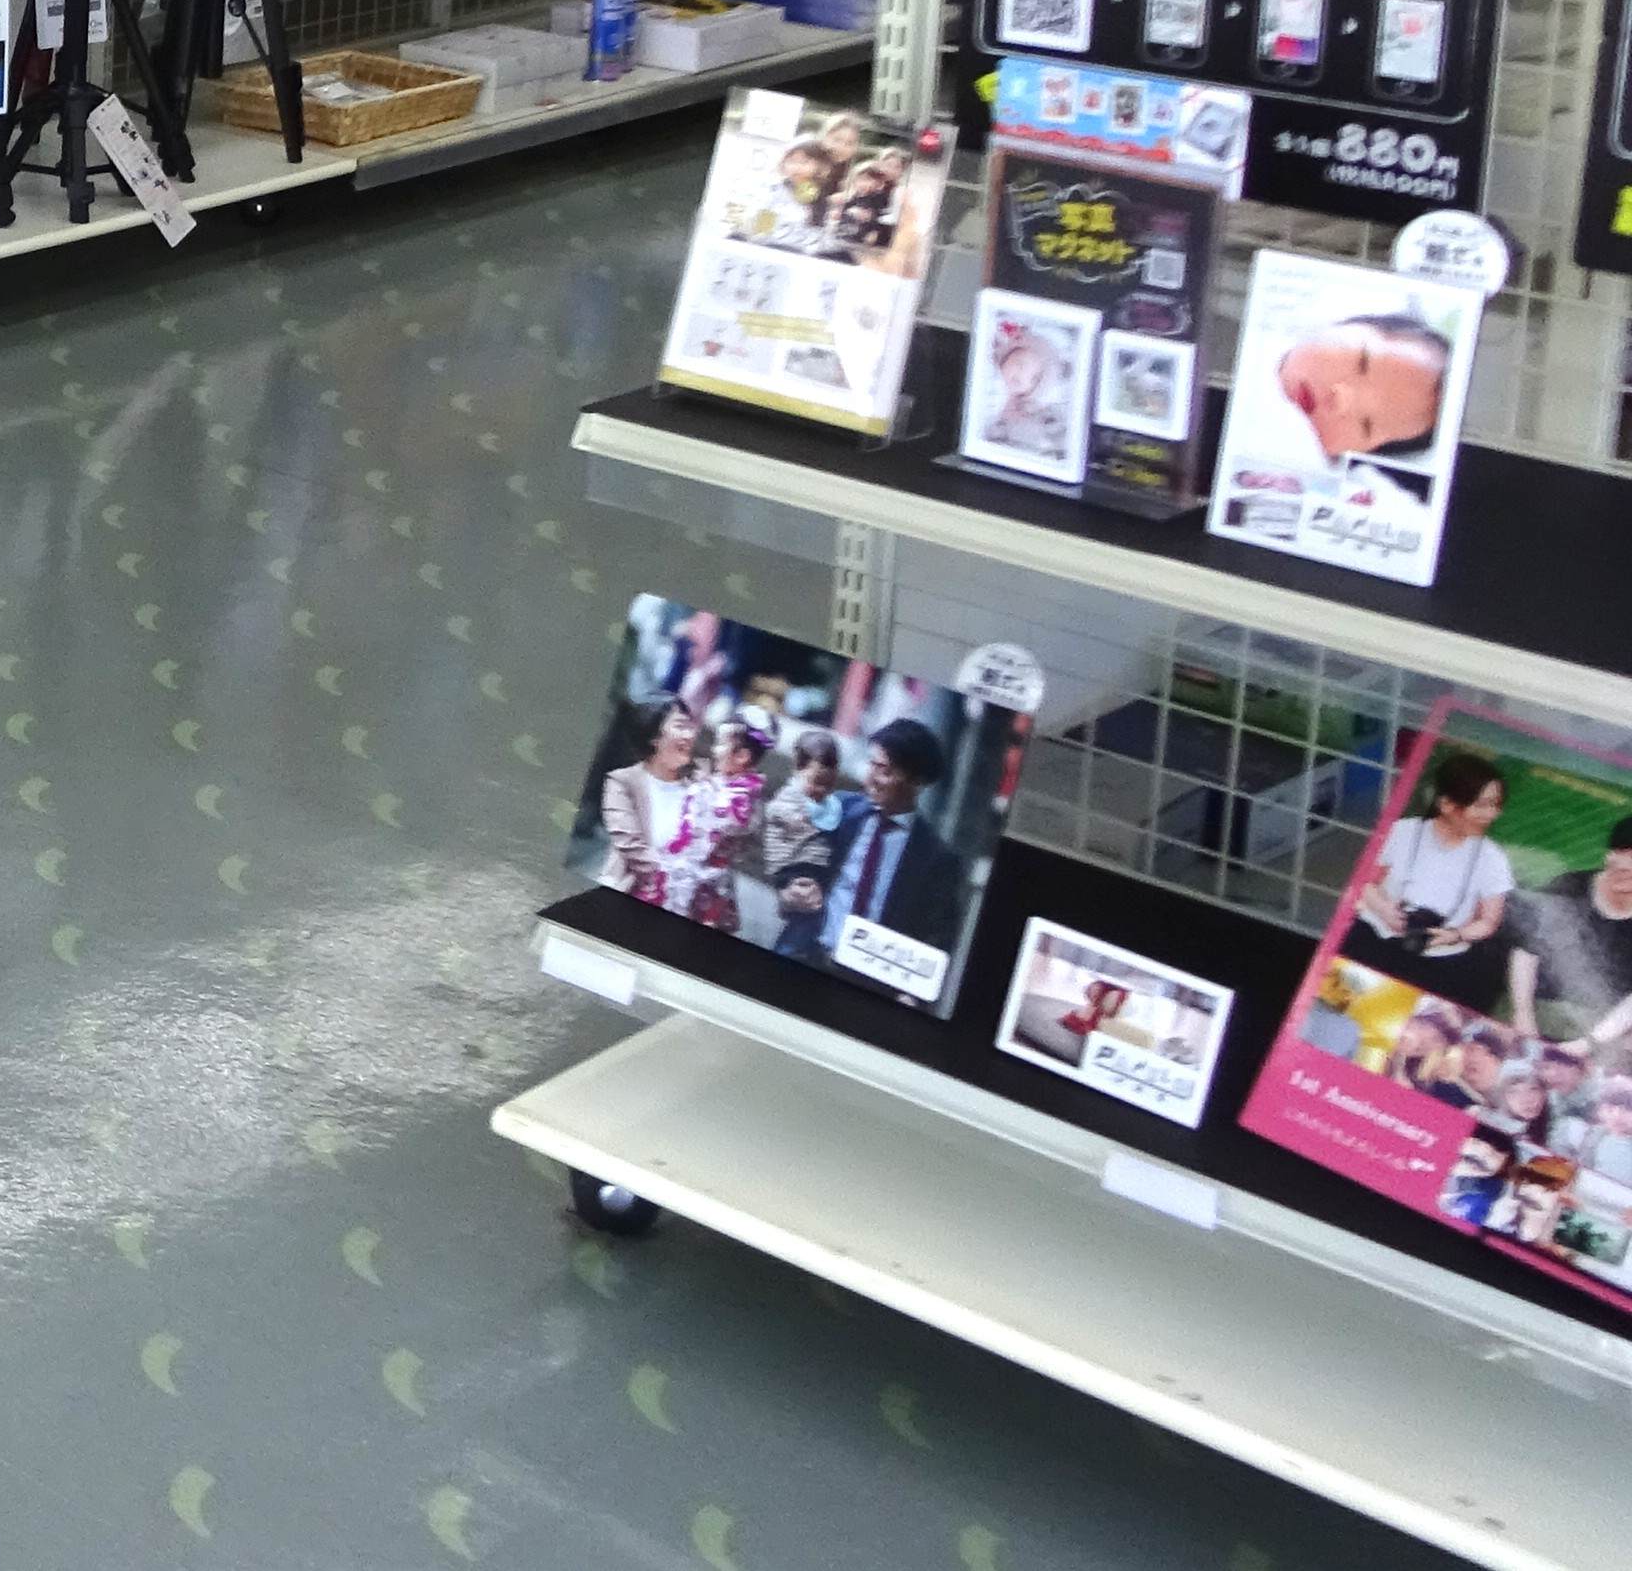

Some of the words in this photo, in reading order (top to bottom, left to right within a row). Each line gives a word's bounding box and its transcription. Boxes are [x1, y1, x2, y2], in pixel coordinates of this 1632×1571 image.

[1031, 231, 1137, 266] マグネット
[1328, 1078, 1439, 1148] Anniversary
